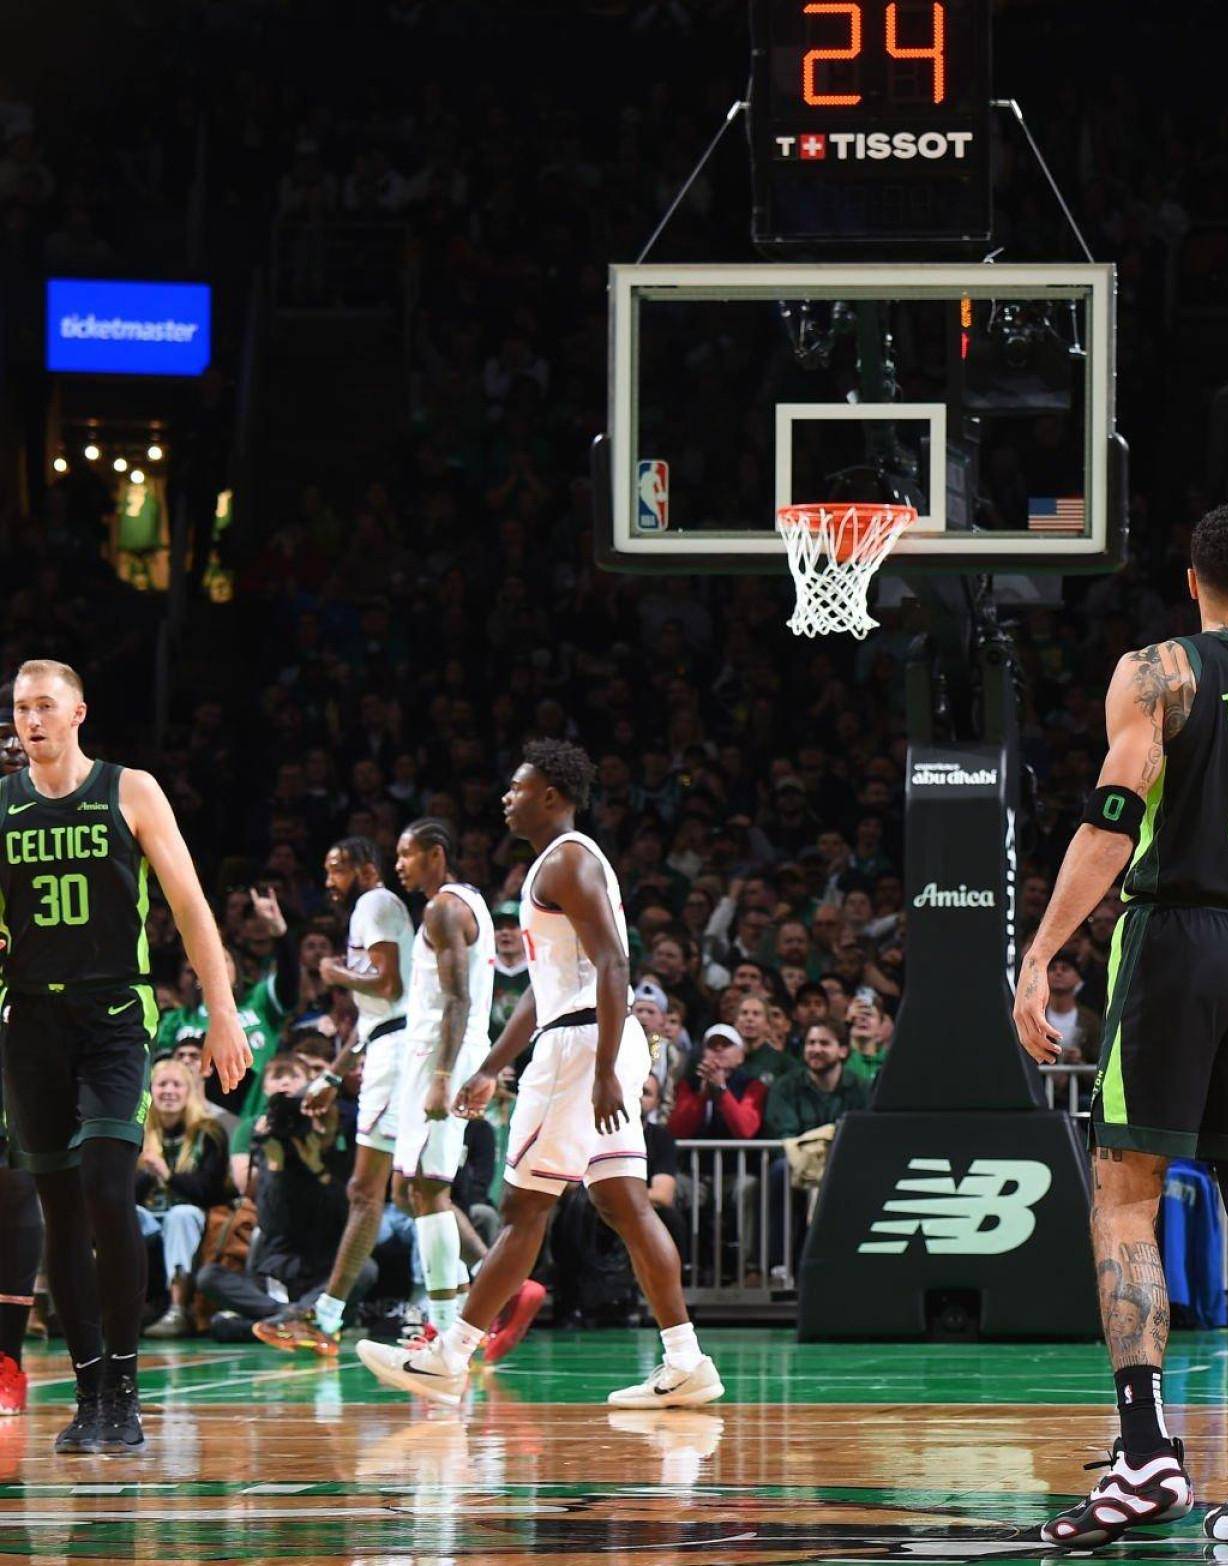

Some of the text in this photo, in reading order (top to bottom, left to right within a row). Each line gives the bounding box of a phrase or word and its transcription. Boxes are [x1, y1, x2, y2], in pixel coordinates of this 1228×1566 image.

[803, 2, 944, 106] 24
[829, 131, 973, 160] TISSOT
[60, 313, 199, 342] ticketmaster
[1102, 793, 1125, 822] 0
[6, 824, 109, 865] CELTICS
[32, 873, 90, 927] 30
[913, 882, 996, 908] Amica
